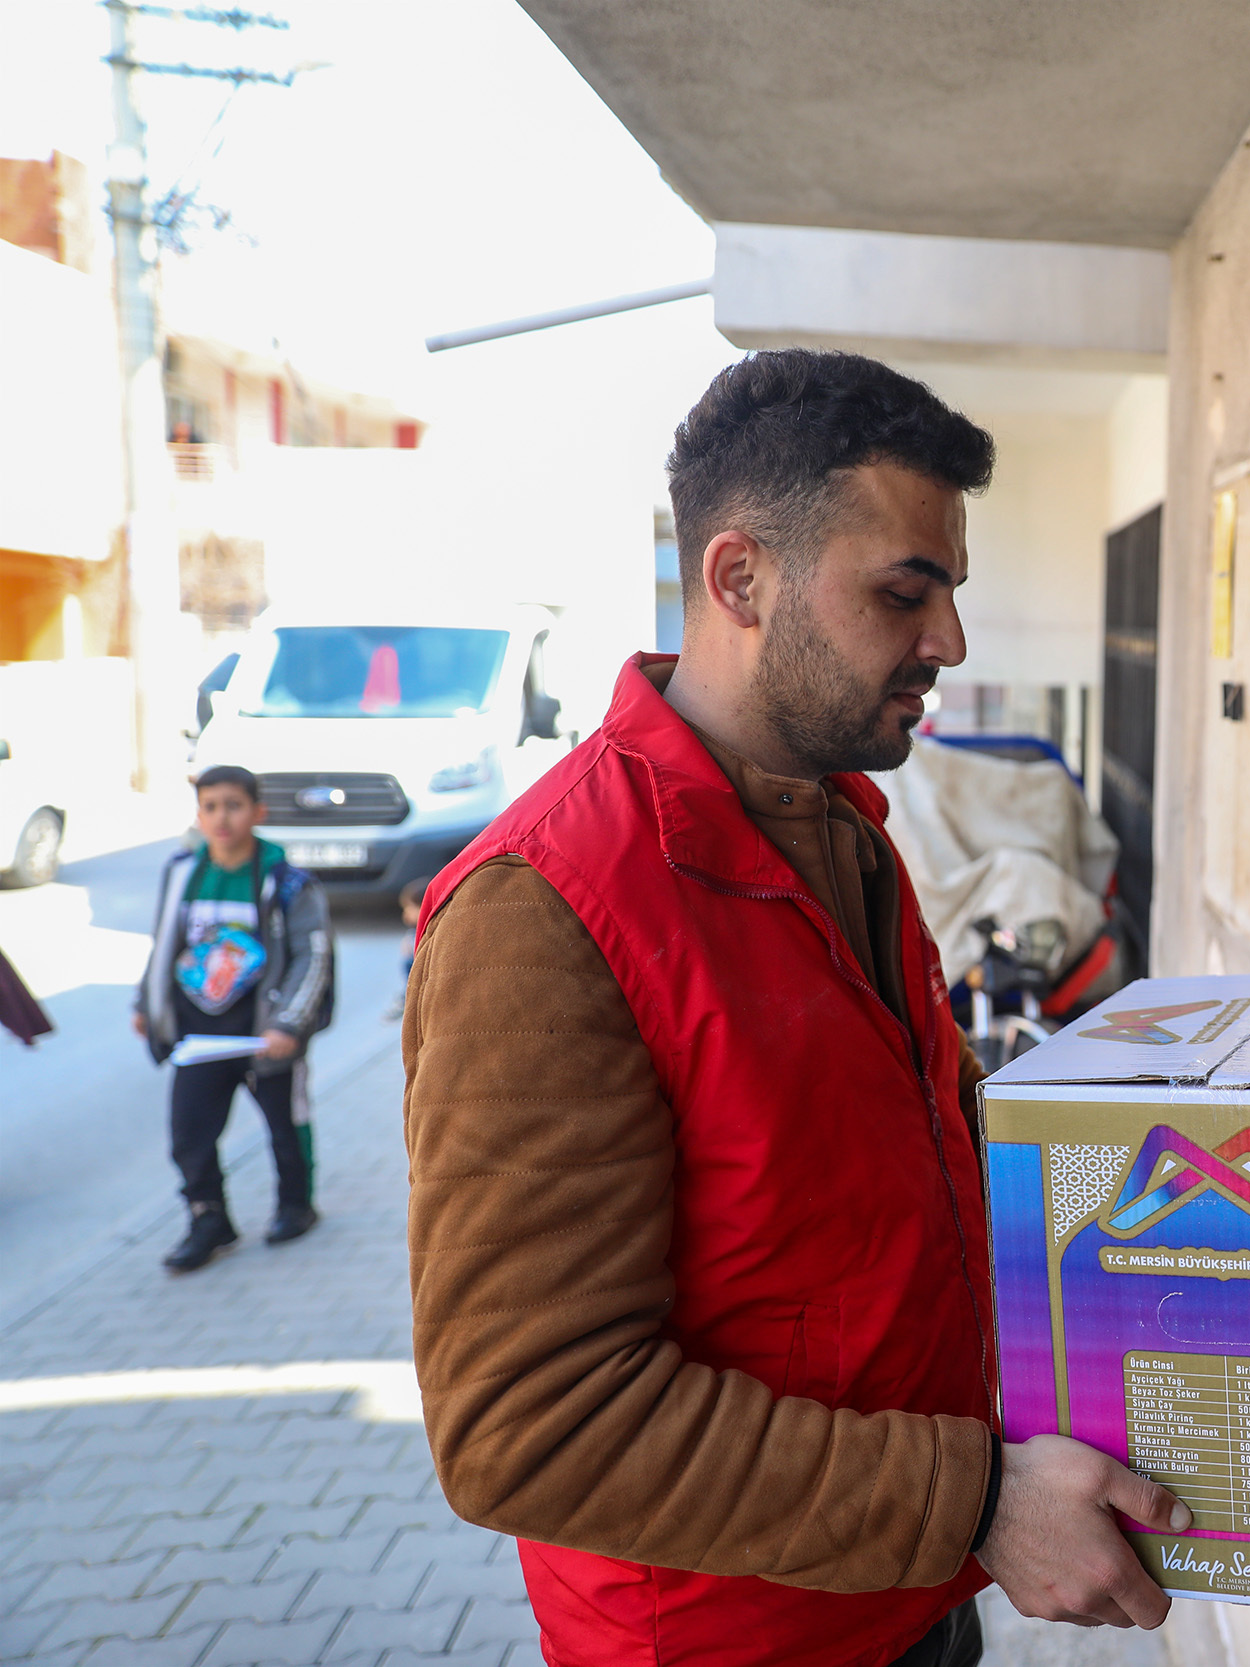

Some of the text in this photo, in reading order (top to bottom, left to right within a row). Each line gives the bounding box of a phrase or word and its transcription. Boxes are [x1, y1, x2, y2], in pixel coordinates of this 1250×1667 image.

[1107, 1255, 1126, 1265] T.C.
[1129, 1254, 1174, 1267] MERSİN
[1130, 1357, 1174, 1370] Ürün Cinsi
[1131, 1374, 1185, 1386] Ayçiçek Yağı
[1237, 1381, 1250, 1389] 1 lt
[1132, 1387, 1200, 1399] Beyaz Toz Şeker
[1133, 1399, 1173, 1410] Siyah Çay
[1133, 1411, 1194, 1423] Pilavlık Pirinç
[1239, 1418, 1243, 1426] 1
[1134, 1423, 1219, 1436] Kırmızı İç Mercimek
[1239, 1430, 1244, 1438] 1
[1135, 1435, 1171, 1446] Makarna
[1135, 1448, 1199, 1461] Sofralık Zeytin
[1136, 1460, 1199, 1473] Pilavlık Bulgur
[1241, 1468, 1245, 1476] 1
[1243, 1505, 1247, 1513] 1
[1161, 1543, 1225, 1586] Vahap
[1217, 1583, 1244, 1591] BELEDİYE
